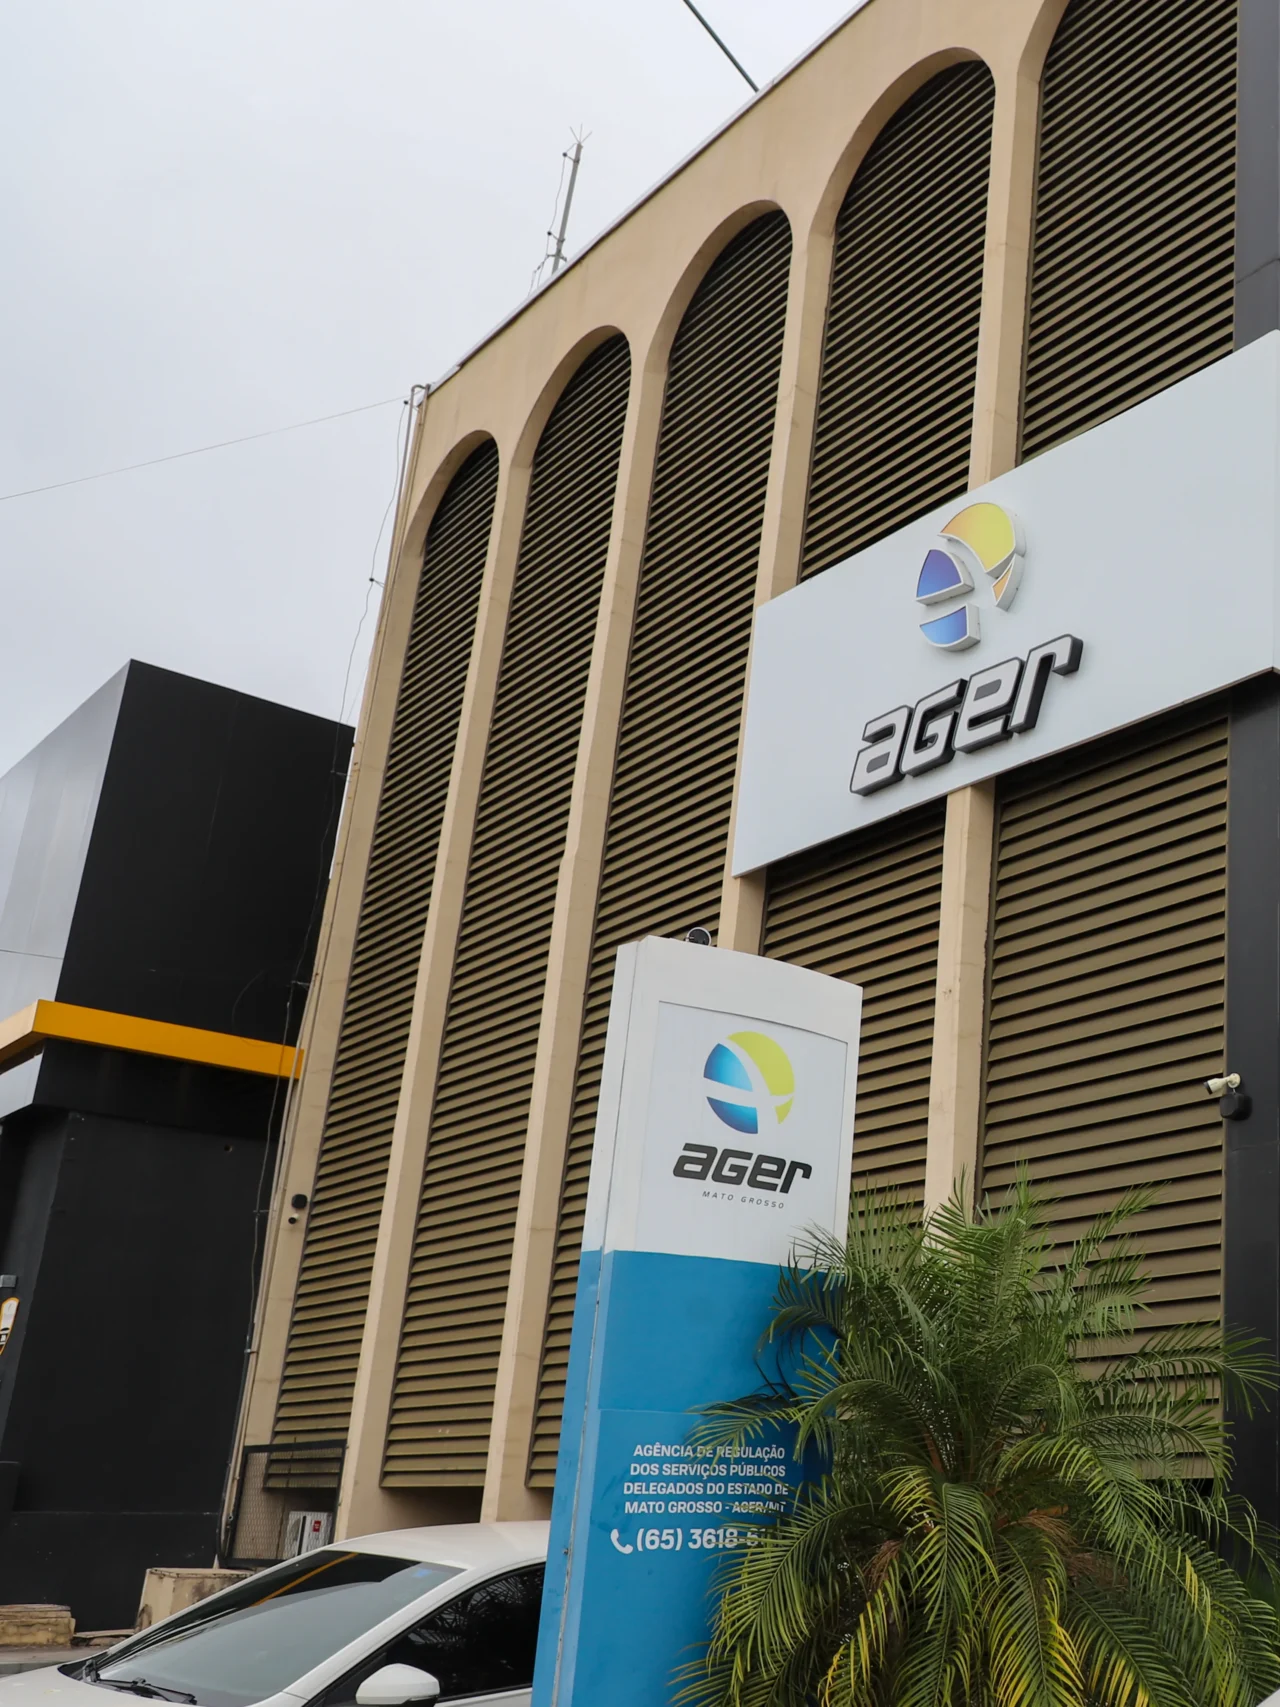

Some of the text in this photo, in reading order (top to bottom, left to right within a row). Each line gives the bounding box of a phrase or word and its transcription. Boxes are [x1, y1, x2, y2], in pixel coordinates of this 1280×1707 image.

[702, 1191, 785, 1209] MATO GROSSO
[633, 1442, 785, 1462] AGÊNCIA DE REGULAÇÃO
[630, 1462, 786, 1480] DOS SERVIÇOS PÚBLICOS
[623, 1482, 788, 1495] DELEGADOS DO ESTADO DE
[624, 1501, 666, 1513] MATO
[668, 1501, 722, 1513] GROSSO
[637, 1528, 683, 1551] (65)
